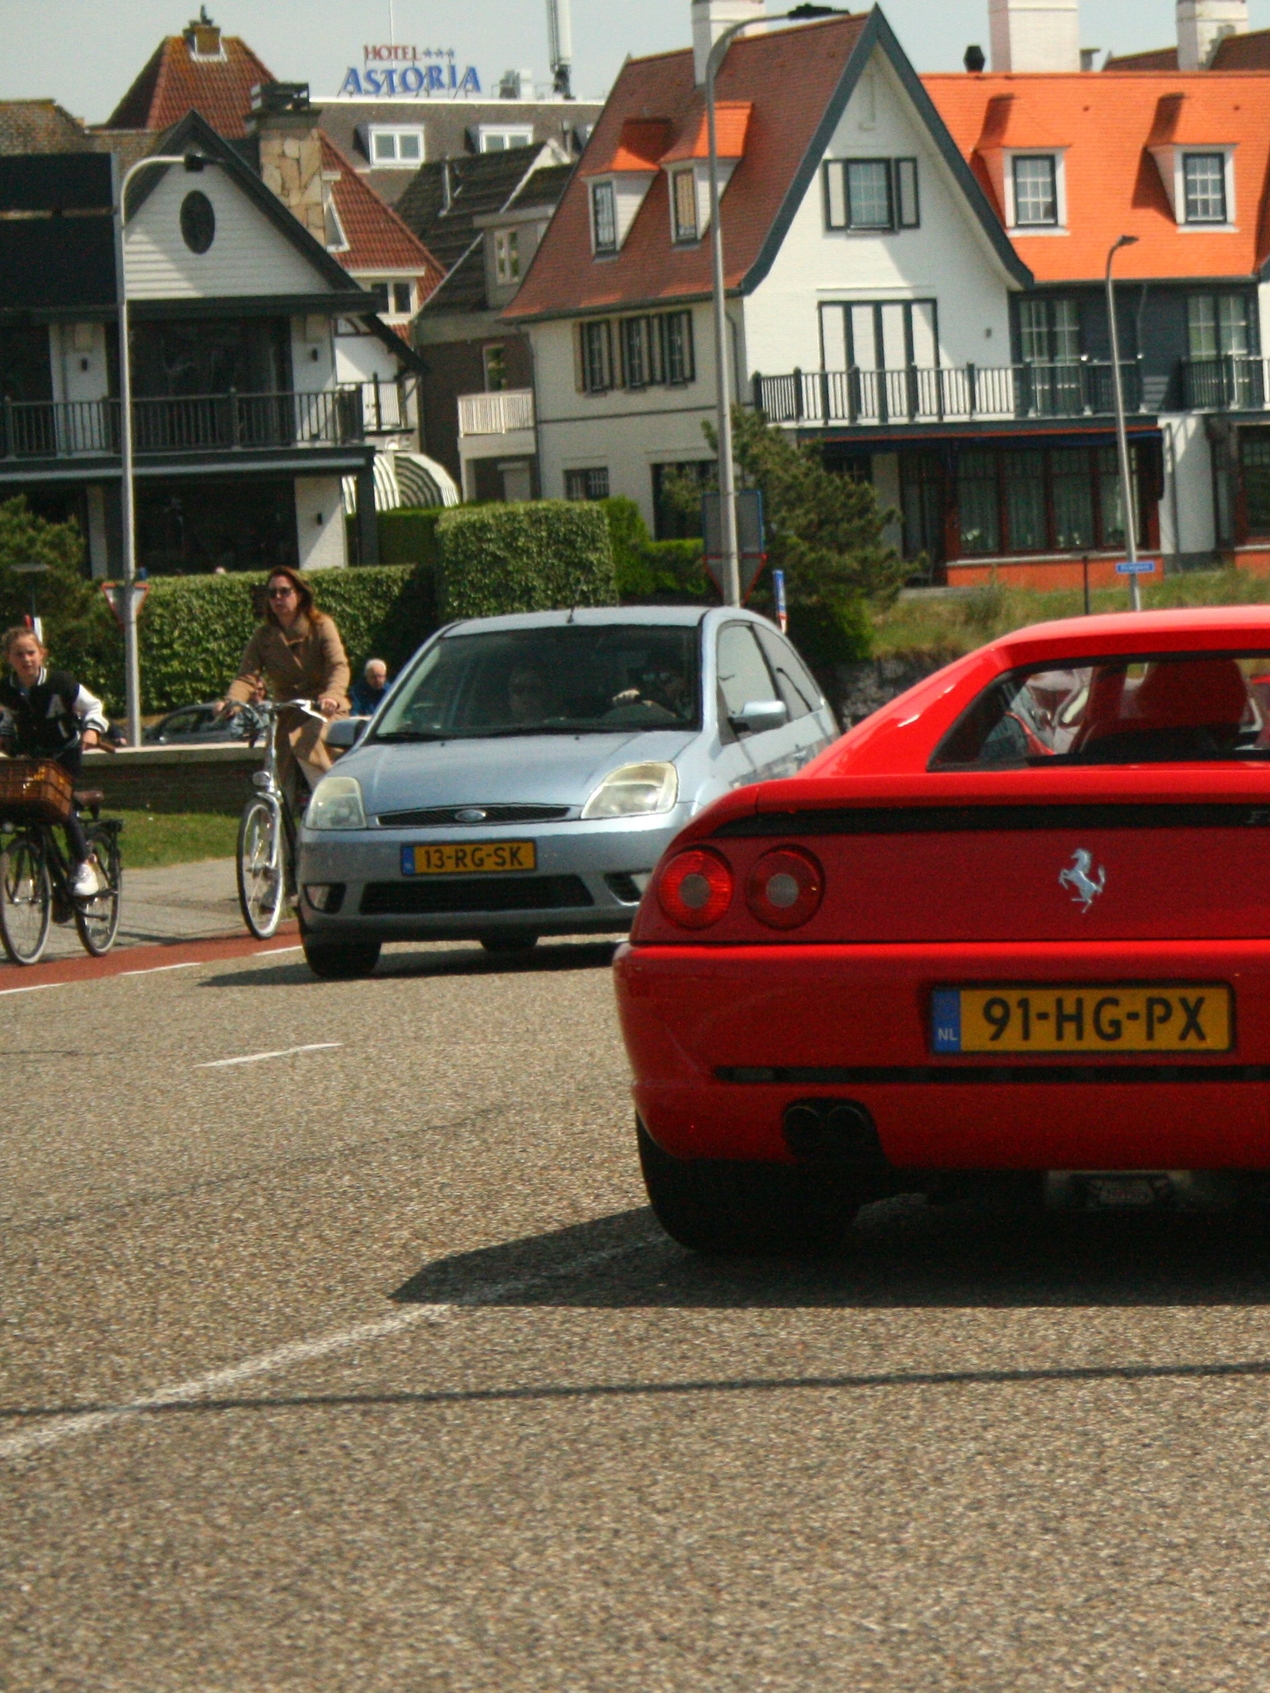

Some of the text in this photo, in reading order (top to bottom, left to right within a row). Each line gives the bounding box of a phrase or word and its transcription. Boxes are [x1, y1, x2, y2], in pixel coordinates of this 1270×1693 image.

[363, 45, 422, 62] HOTEL
[341, 64, 482, 95] ASTORIA
[423, 845, 525, 870] 13-RG-SK
[982, 997, 1207, 1042] 91-HG-PX
[937, 1028, 958, 1041] NL
